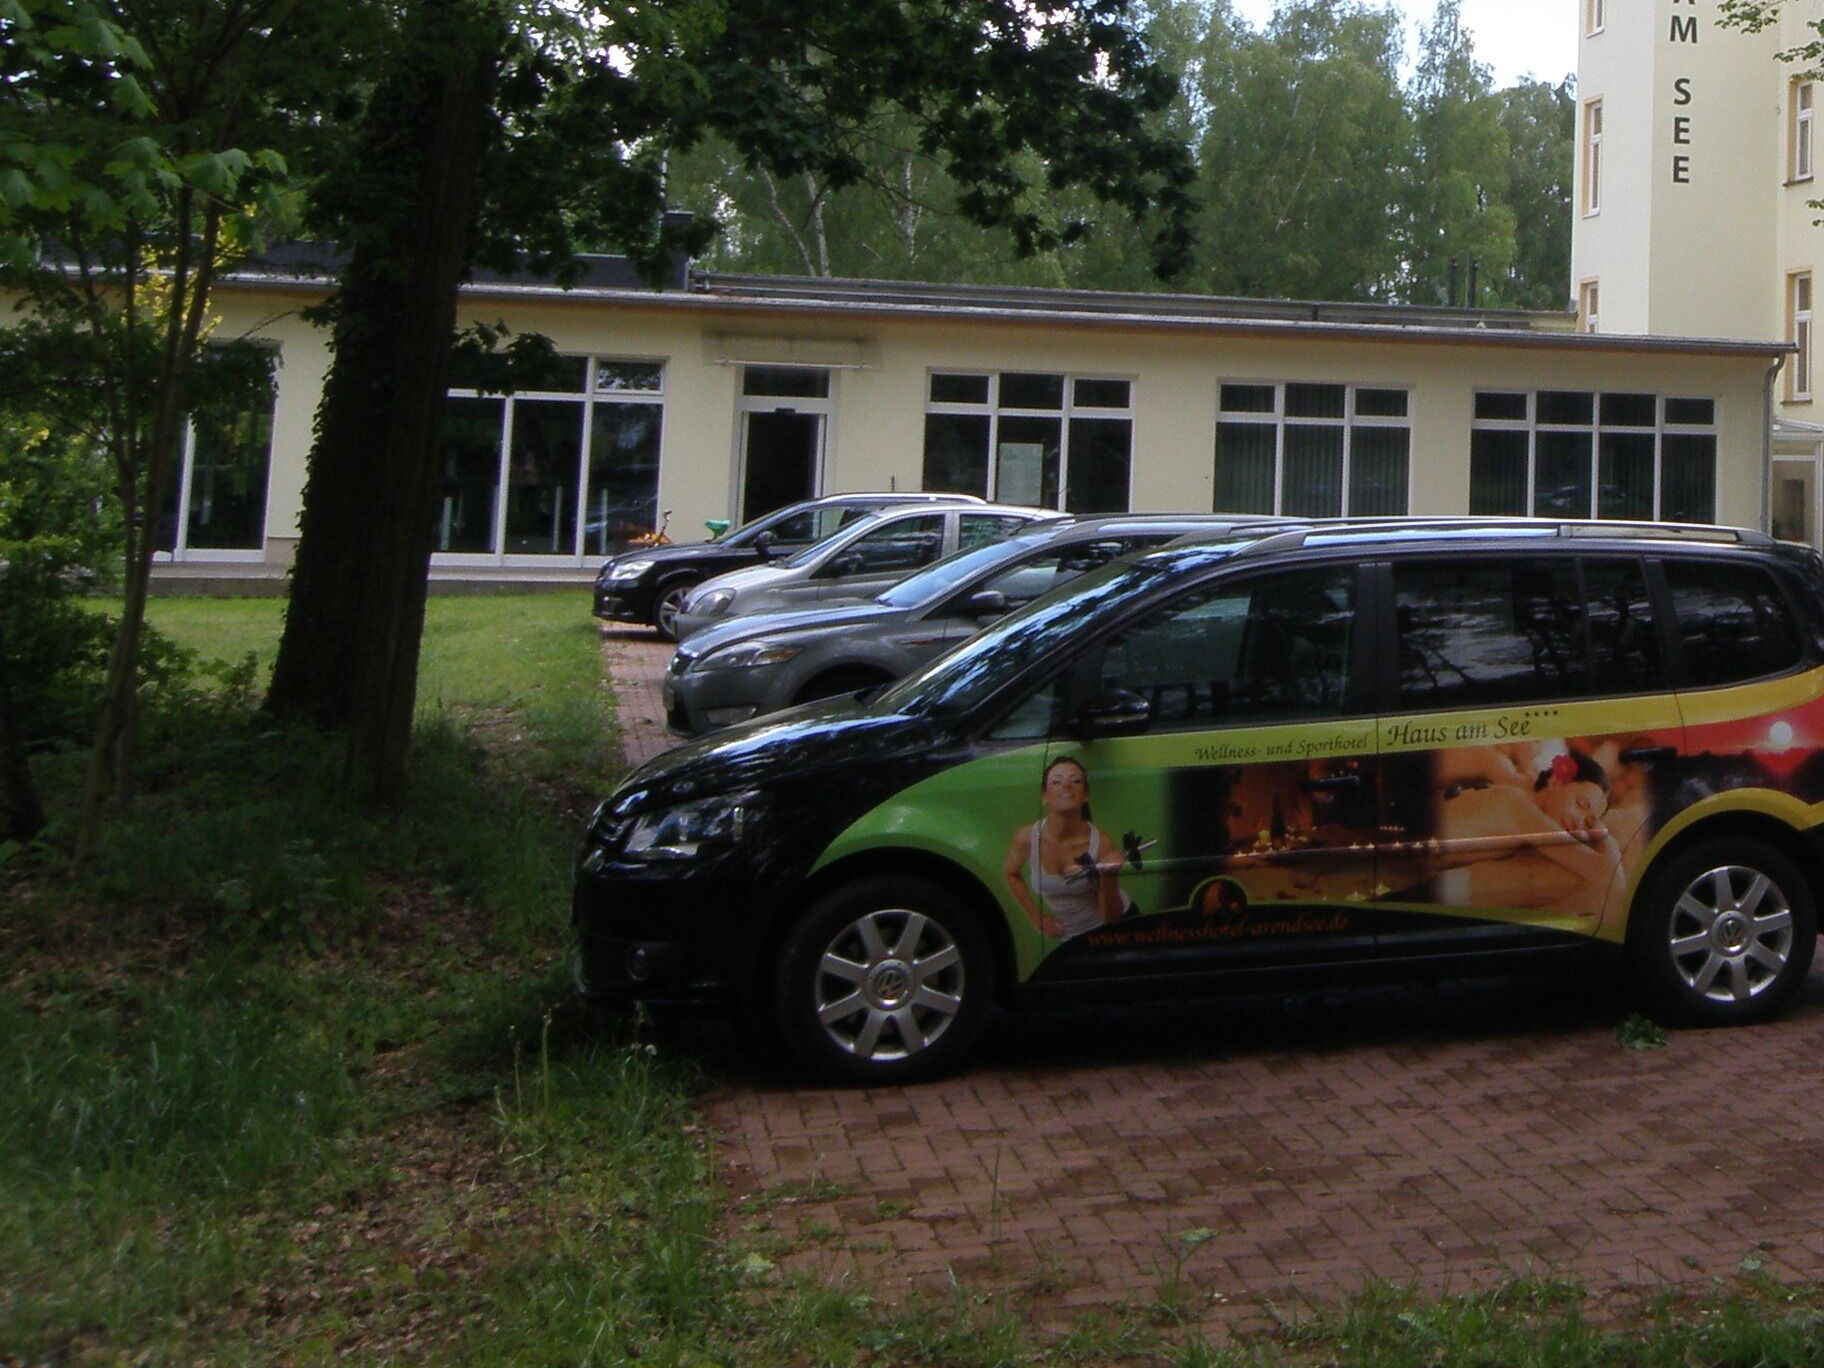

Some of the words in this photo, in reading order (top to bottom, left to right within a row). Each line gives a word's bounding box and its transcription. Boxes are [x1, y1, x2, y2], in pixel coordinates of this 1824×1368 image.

[1672, 78, 1692, 184] SEE
[1387, 721, 1447, 746] Haus
[1455, 724, 1488, 740] am
[1494, 716, 1531, 739] See
[1195, 746, 1261, 761] Wellness-
[1267, 743, 1293, 755] und
[1296, 735, 1368, 756] Sporthotel
